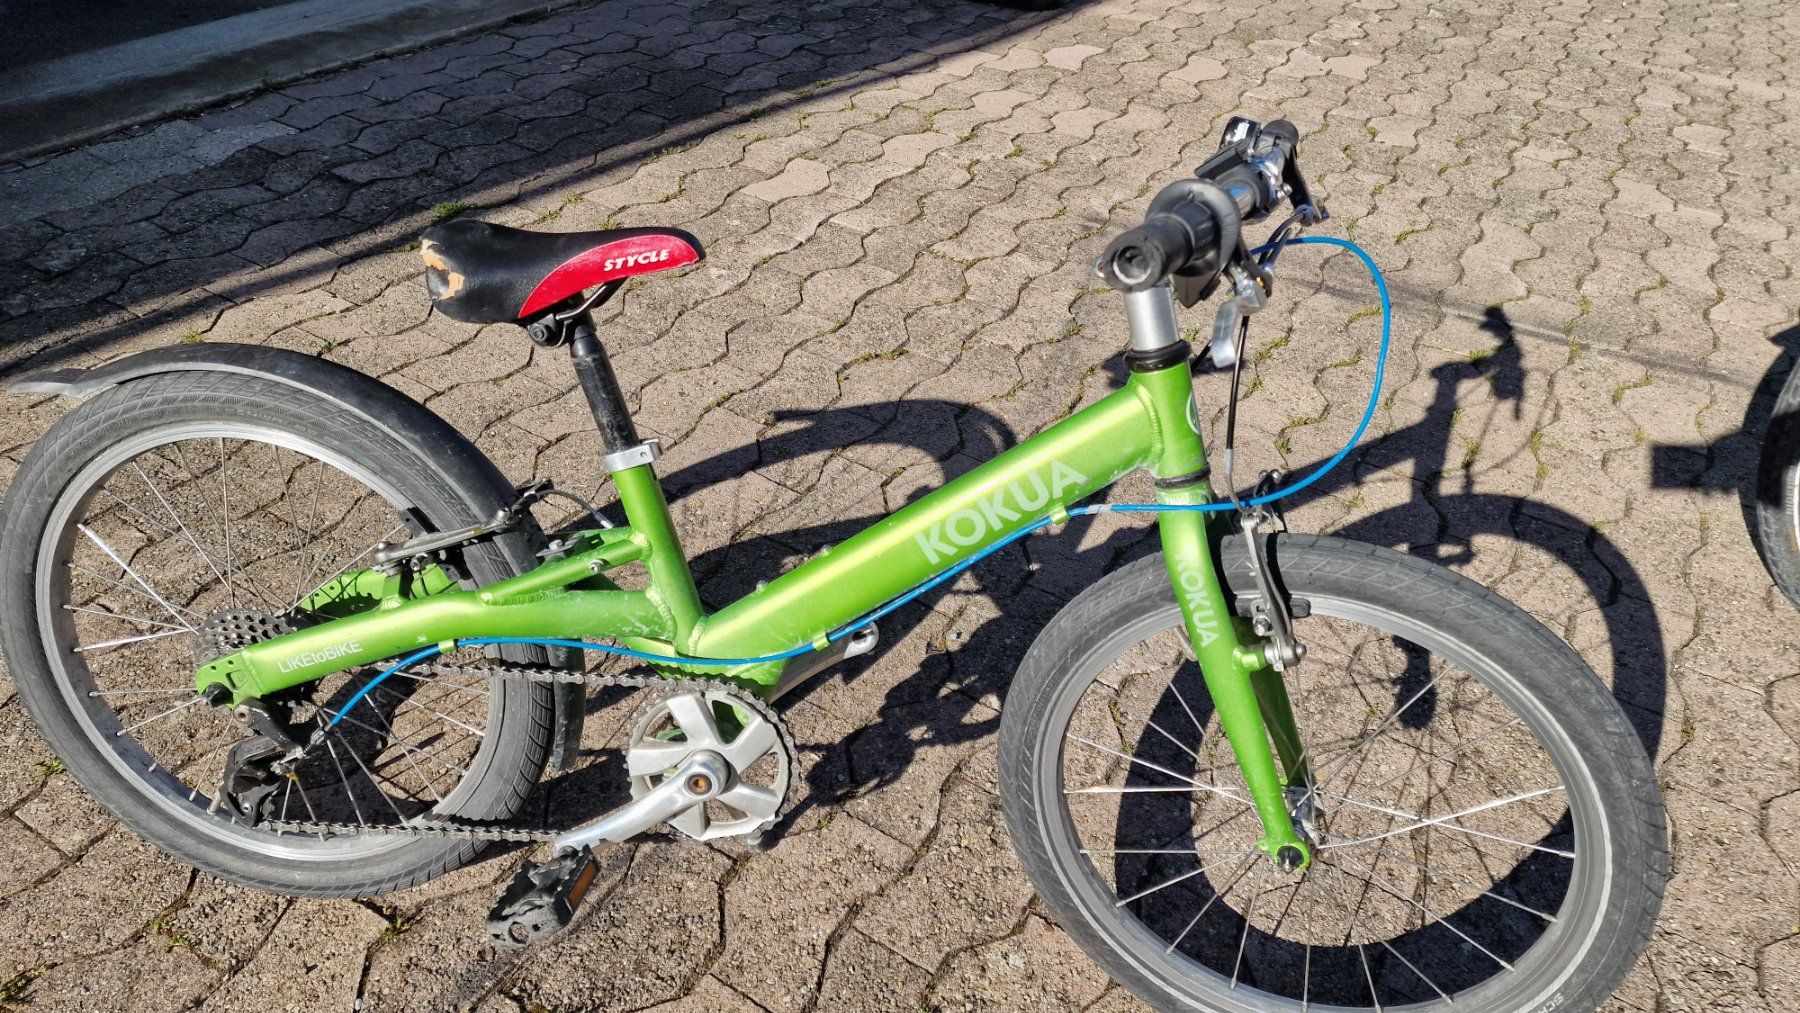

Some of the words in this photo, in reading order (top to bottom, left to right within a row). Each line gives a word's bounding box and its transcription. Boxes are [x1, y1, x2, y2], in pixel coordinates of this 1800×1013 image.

[604, 249, 670, 272] STYCLE
[915, 460, 1089, 565] KOKUA
[1174, 552, 1220, 648] KOKUA
[278, 640, 363, 673] LIKEtoBIKE
